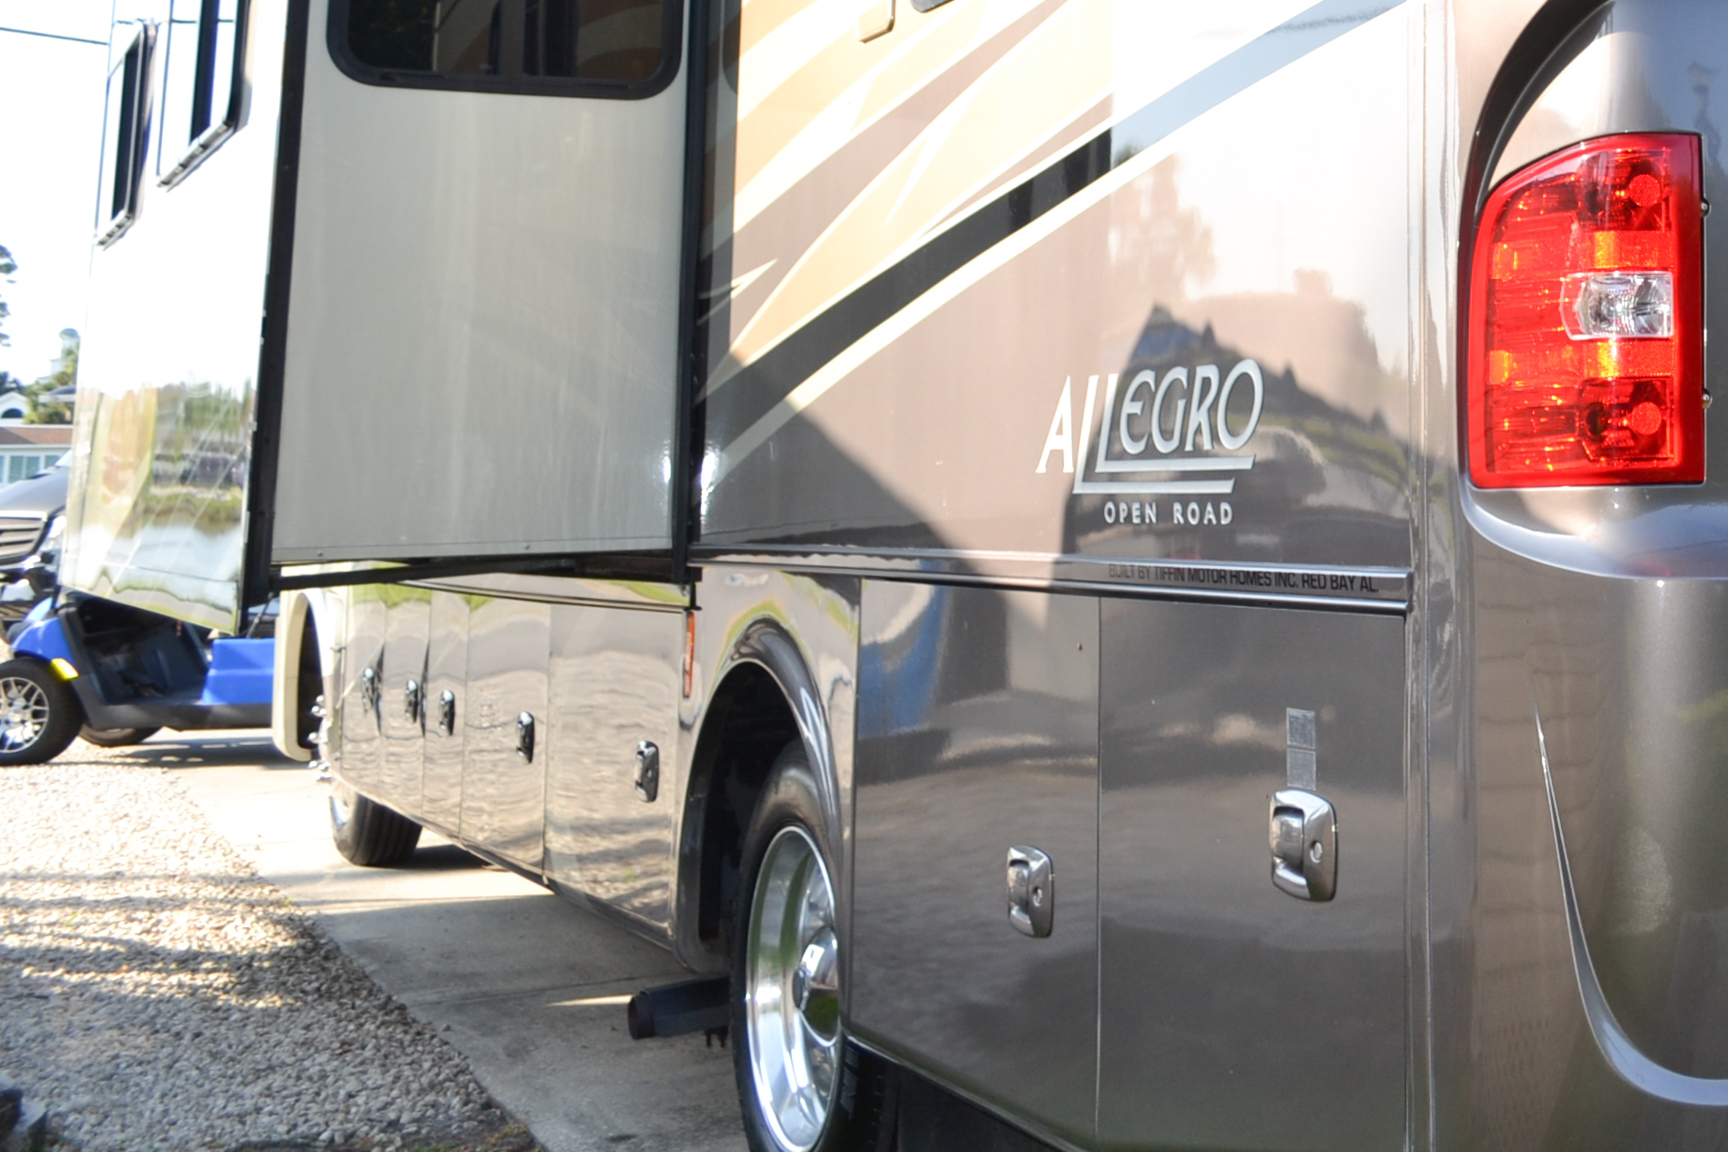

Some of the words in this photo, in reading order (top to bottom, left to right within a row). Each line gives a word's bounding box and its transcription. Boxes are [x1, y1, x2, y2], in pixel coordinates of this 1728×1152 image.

[1035, 358, 1265, 495] ALLEGRO
[1103, 501, 1158, 525] OPEN
[1172, 501, 1234, 526] ROAD
[1108, 564, 1137, 579] BUILT
[1138, 565, 1152, 580] BY
[1154, 566, 1186, 582] TIFFIN
[1187, 567, 1228, 585] MOTOR
[1229, 569, 1272, 587] HOMES
[1274, 571, 1299, 589] INC.
[1301, 572, 1328, 590] RED
[1329, 574, 1357, 592] BAY
[1359, 576, 1380, 594] AL.
